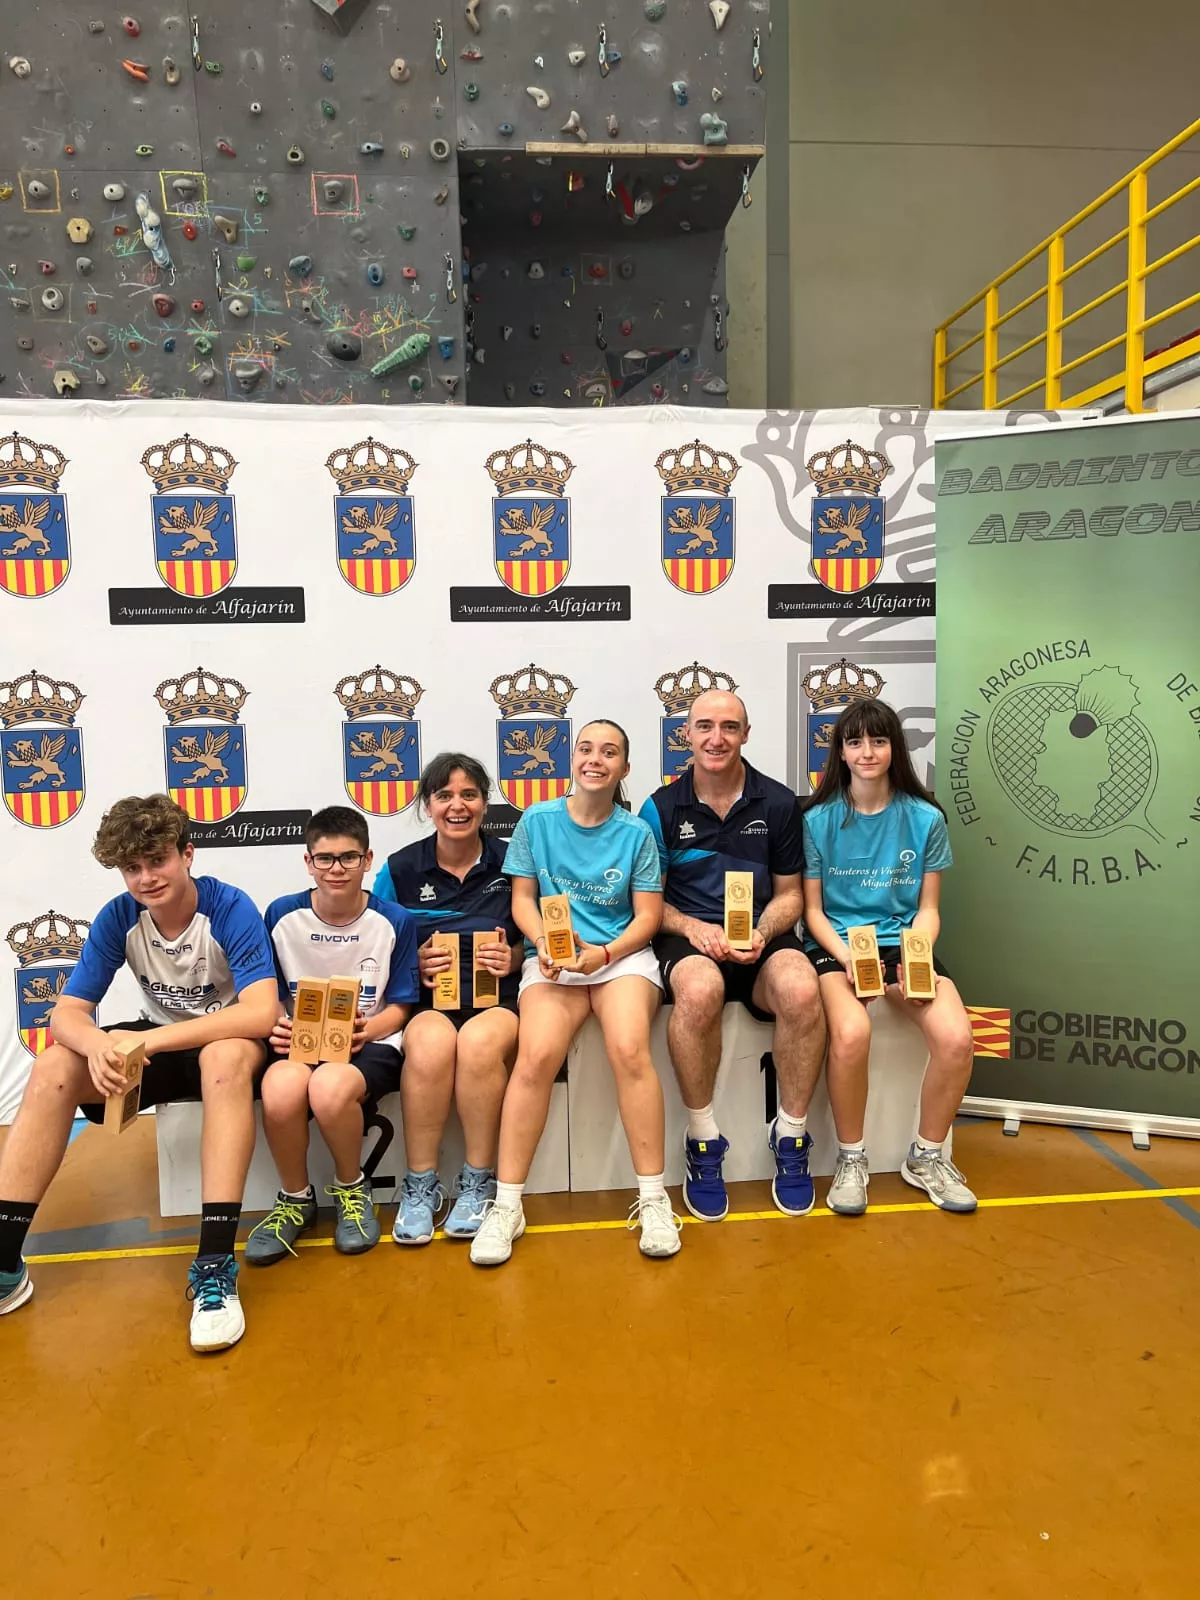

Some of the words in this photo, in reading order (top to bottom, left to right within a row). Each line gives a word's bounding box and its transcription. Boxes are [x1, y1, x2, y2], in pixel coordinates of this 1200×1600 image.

[968, 499, 1200, 545] ARAGON
[118, 606, 193, 618] Ayuntamiento
[195, 605, 208, 615] de
[211, 598, 296, 620] Alfajarín
[458, 604, 528, 616] Ayuntamiento
[530, 603, 541, 613] de
[775, 601, 842, 613] Ayuntamiento
[843, 600, 854, 609] de
[857, 593, 932, 614] Alfajarín
[949, 708, 982, 827] FEDERACION
[978, 639, 1092, 704] ARAGONESA
[1166, 672, 1200, 703] DE
[205, 829, 217, 839] de
[221, 821, 304, 843] Alfajarín
[827, 865, 870, 877] Planteros
[869, 867, 878, 879] y
[880, 866, 909, 876] Viveros
[1015, 844, 1162, 886] F.A.R.B.A.
[570, 880, 580, 890] y
[581, 879, 614, 894] Viveros
[860, 878, 893, 891] Miguel
[310, 932, 361, 944] GIVOVA
[1014, 1009, 1188, 1046] GOBIERNO
[1014, 1035, 1057, 1063] DE
